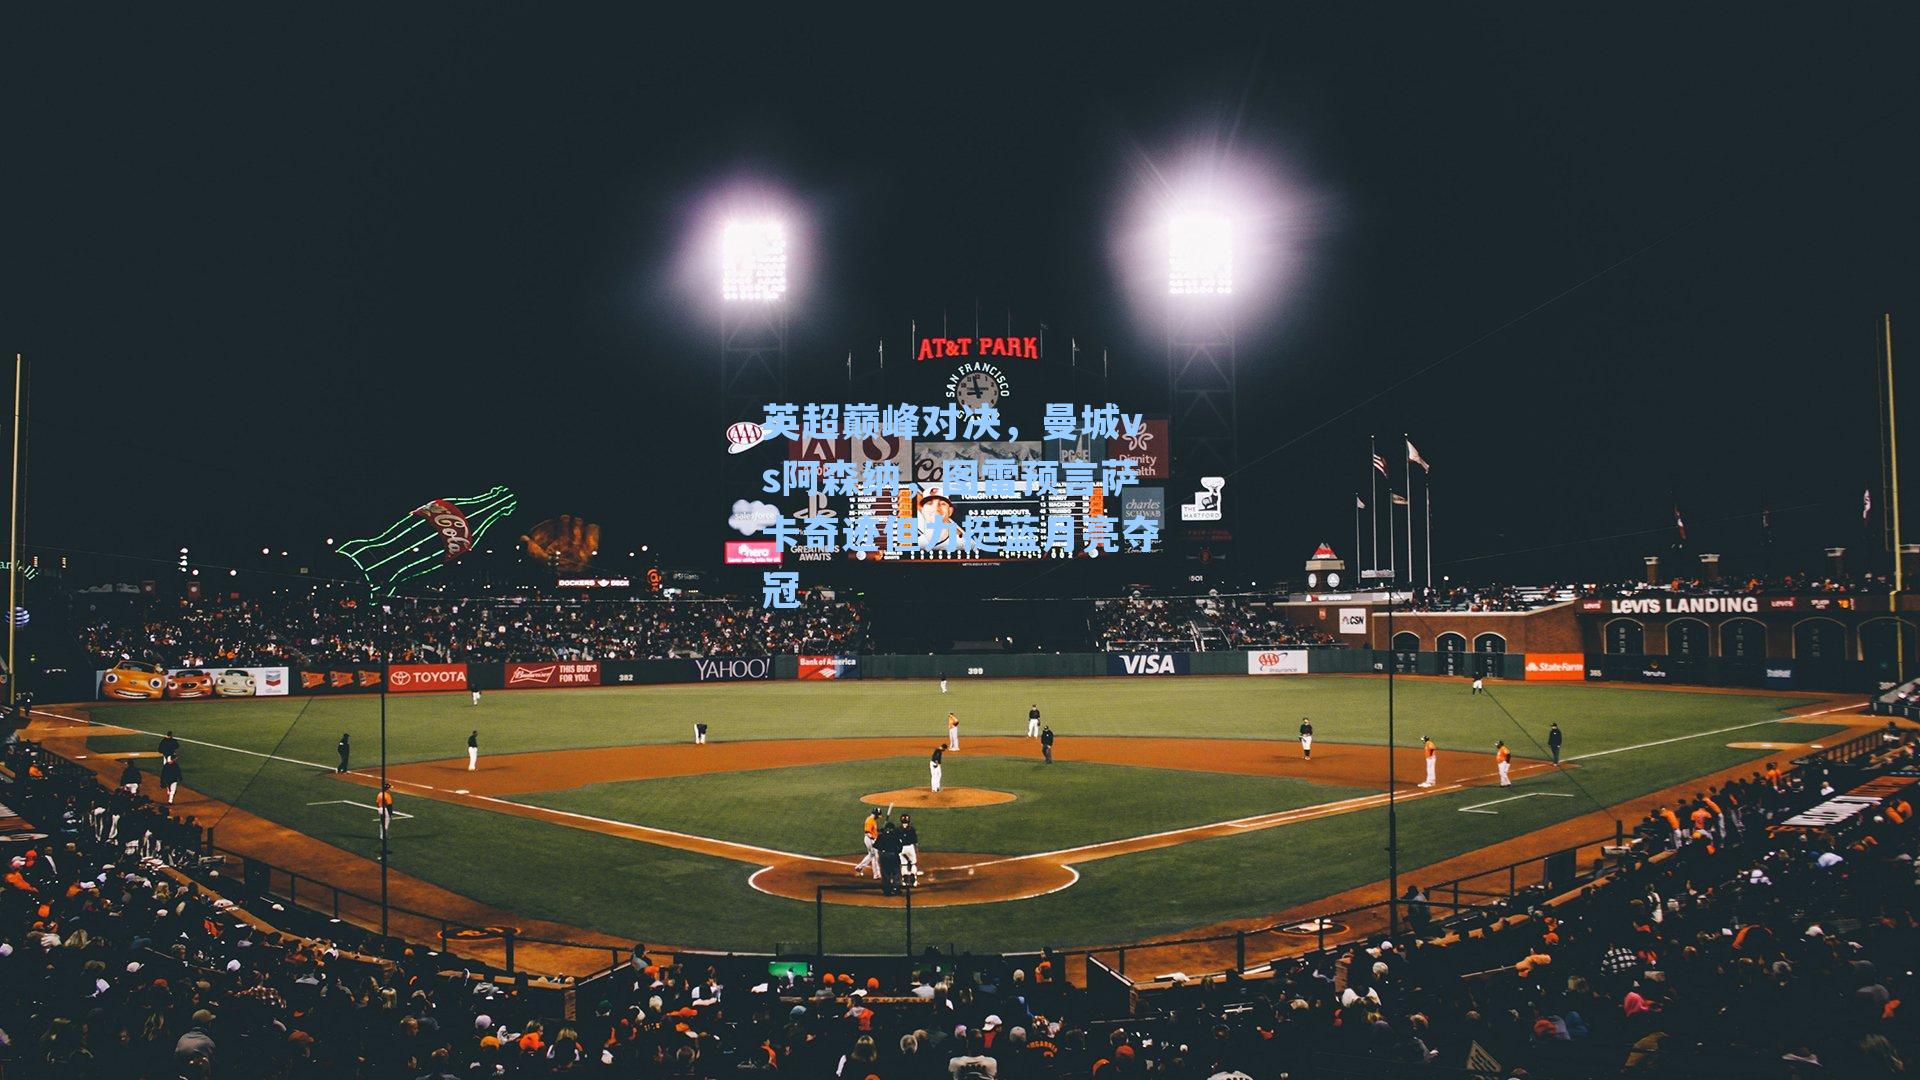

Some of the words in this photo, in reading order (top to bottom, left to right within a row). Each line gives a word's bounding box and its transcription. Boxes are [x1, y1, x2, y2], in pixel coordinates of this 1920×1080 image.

[918, 337, 972, 360] AT&T
[979, 336, 1038, 359] PARK
[945, 374, 960, 398] SAN
[958, 361, 1010, 397] FRANCISCO
[1125, 499, 1160, 510] charles
[790, 545, 840, 553] GREATNS
[799, 553, 832, 561] AWAITS
[1665, 597, 1758, 613] LANDING
[1350, 616, 1364, 625] CSN
[800, 658, 818, 666] Bank
[818, 658, 826, 666] of
[826, 658, 856, 666] America
[1119, 654, 1176, 674] VISA
[559, 665, 576, 673] THIS
[576, 664, 598, 673] BUD'S
[695, 658, 771, 680] YAHOO!
[413, 671, 466, 683] TOYOTA
[559, 674, 574, 683] FOR
[575, 673, 590, 683] YOU.
